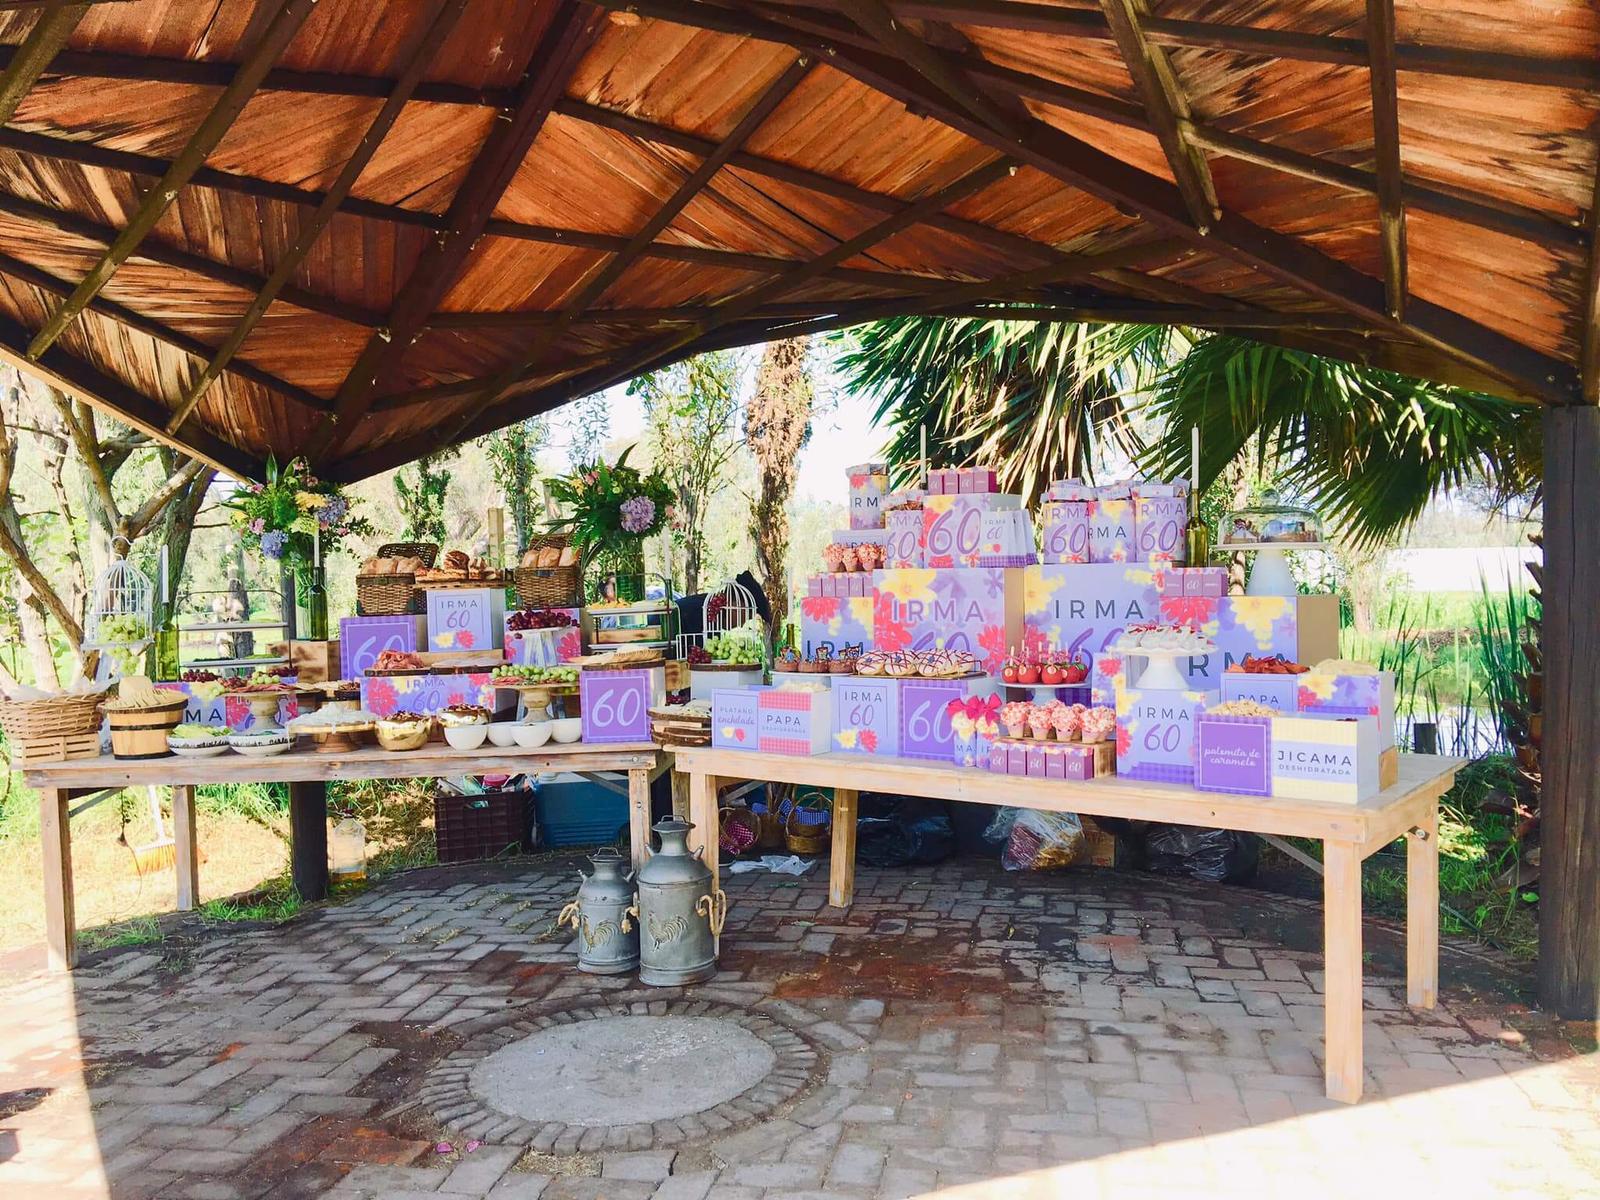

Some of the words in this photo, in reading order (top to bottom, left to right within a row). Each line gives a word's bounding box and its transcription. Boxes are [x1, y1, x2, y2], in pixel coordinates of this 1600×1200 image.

[850, 496, 879, 509] IRM
[928, 507, 981, 555] 60
[1050, 522, 1087, 554] 60
[1087, 525, 1127, 539] RMA
[1140, 519, 1178, 552] 60
[886, 531, 916, 559] 60
[441, 599, 478, 609] IRMA
[893, 600, 984, 623] IRMA
[1055, 599, 1144, 619] IRMA
[447, 610, 471, 629] 60
[807, 640, 864, 661] IRM
[406, 679, 446, 689] IRMA
[412, 690, 441, 713] 60
[844, 691, 883, 703] IRMA
[592, 687, 641, 728] 60
[850, 704, 874, 726] 60
[1138, 706, 1190, 721] IRMA
[766, 714, 801, 726] PAPA
[1144, 723, 1181, 752] 60
[1249, 748, 1261, 758] de
[1278, 750, 1352, 767] JICAMA
[1279, 763, 1351, 775] DESHIDRATADA
